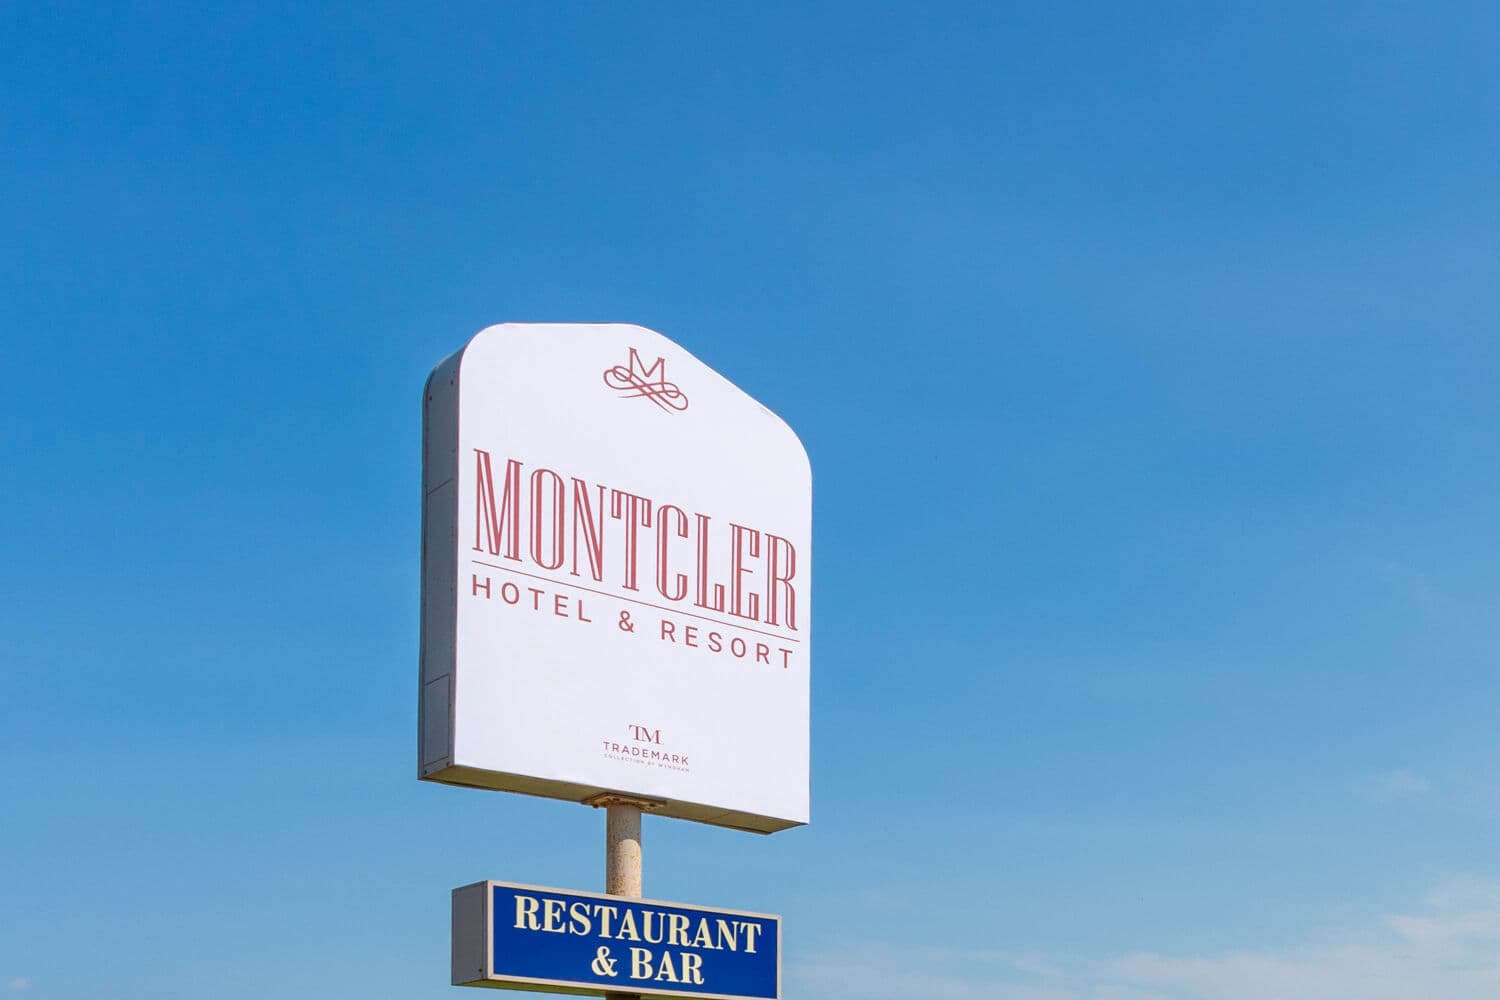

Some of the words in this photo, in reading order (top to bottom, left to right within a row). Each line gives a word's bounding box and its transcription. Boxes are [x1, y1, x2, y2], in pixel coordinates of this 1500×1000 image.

[472, 448, 798, 631] MONTCLER
[472, 574, 592, 623] HOTEL
[618, 610, 634, 633] &
[660, 619, 793, 669] RESORT
[603, 741, 689, 766] TRADEMARK
[628, 724, 664, 745] TM
[513, 894, 762, 954] RESTAURANT
[591, 945, 618, 978] &
[629, 947, 705, 985] BAR
